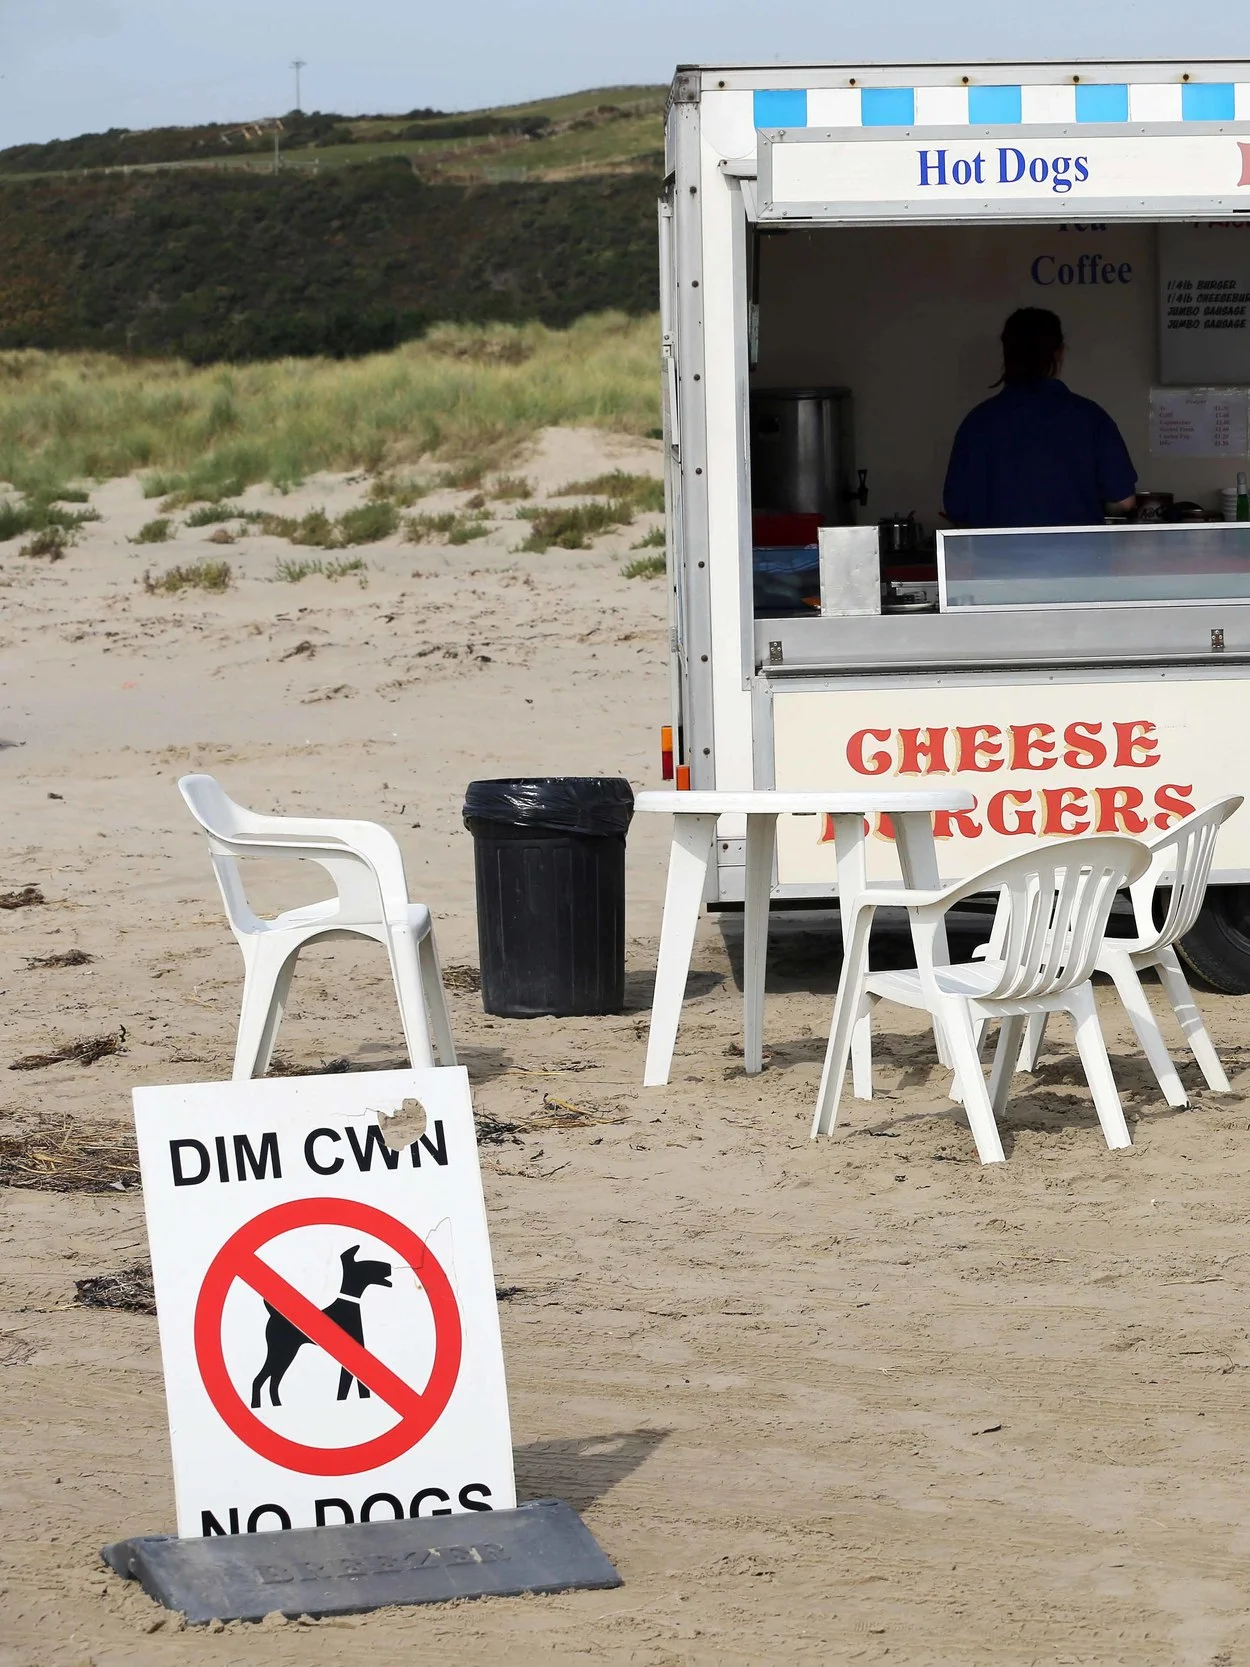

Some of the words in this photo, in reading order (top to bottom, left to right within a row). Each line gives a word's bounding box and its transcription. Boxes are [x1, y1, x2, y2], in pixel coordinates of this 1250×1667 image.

[919, 149, 985, 186] Hot
[998, 147, 1089, 193] Dogs
[1031, 254, 1133, 286] Coffee
[1196, 280, 1237, 290] BURGER
[1167, 306, 1200, 317] JUMBO
[1203, 306, 1247, 316] SAUSAGE
[1167, 319, 1200, 330] JUMBO
[1203, 319, 1247, 329] SAUSAGE
[846, 719, 1161, 776] CHEESE
[169, 1134, 282, 1187] DIM
[201, 1504, 292, 1538] NO
[315, 1483, 493, 1526] DOGS
